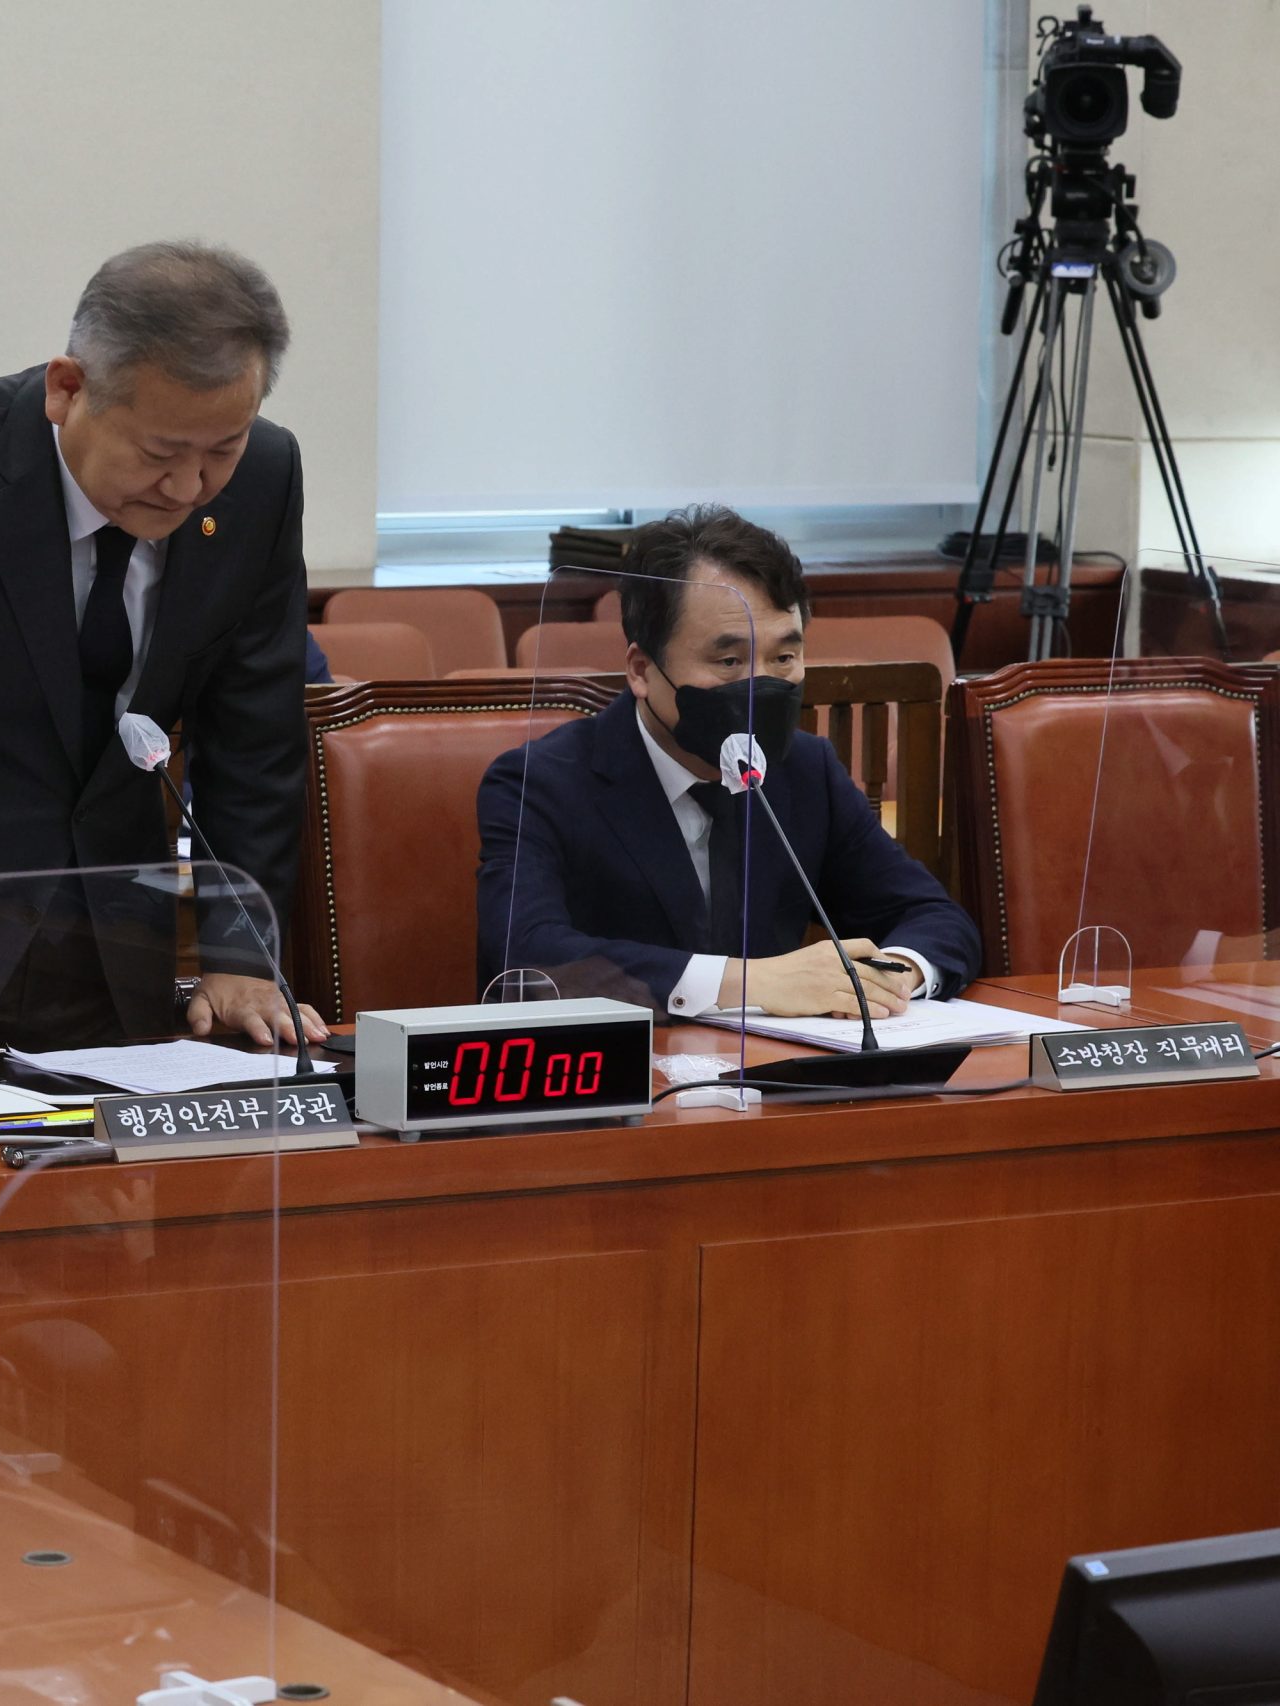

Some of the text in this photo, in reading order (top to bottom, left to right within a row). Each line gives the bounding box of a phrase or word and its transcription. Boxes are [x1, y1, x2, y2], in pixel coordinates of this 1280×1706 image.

[424, 1060, 448, 1070] 발언시간
[1057, 1033, 1245, 1067] 소방청장 직무대리
[448, 1038, 603, 1105] 00 00
[117, 1092, 338, 1137] 행정안전부 장관
